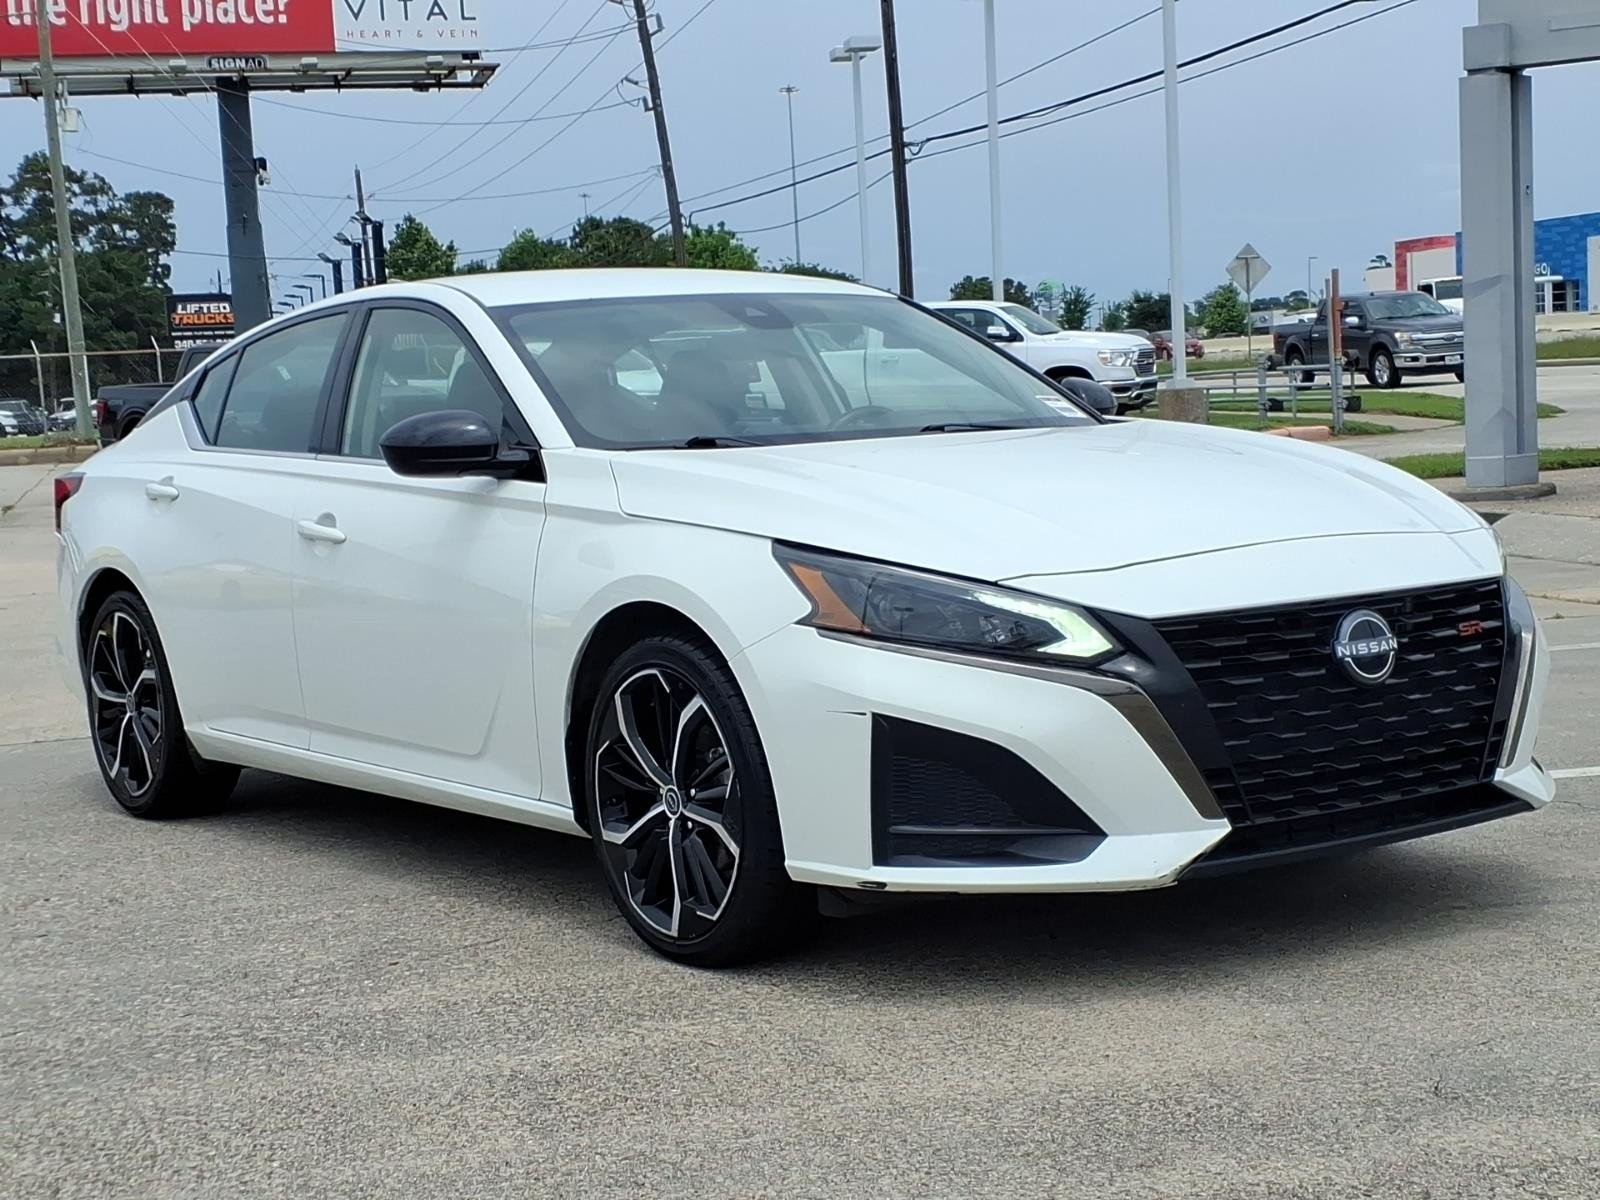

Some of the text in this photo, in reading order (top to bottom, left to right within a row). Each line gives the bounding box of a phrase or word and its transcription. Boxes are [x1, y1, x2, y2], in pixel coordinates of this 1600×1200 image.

[79, 0, 169, 32] right
[344, 0, 477, 21] VITAL
[346, 29, 478, 38] HEART & VEIN
[210, 57, 265, 70] SIGNAD
[177, 303, 231, 314] LIFTED
[174, 313, 235, 324] TRUCKS
[1458, 620, 1483, 637] SR
[1337, 637, 1398, 658] NISSAN
